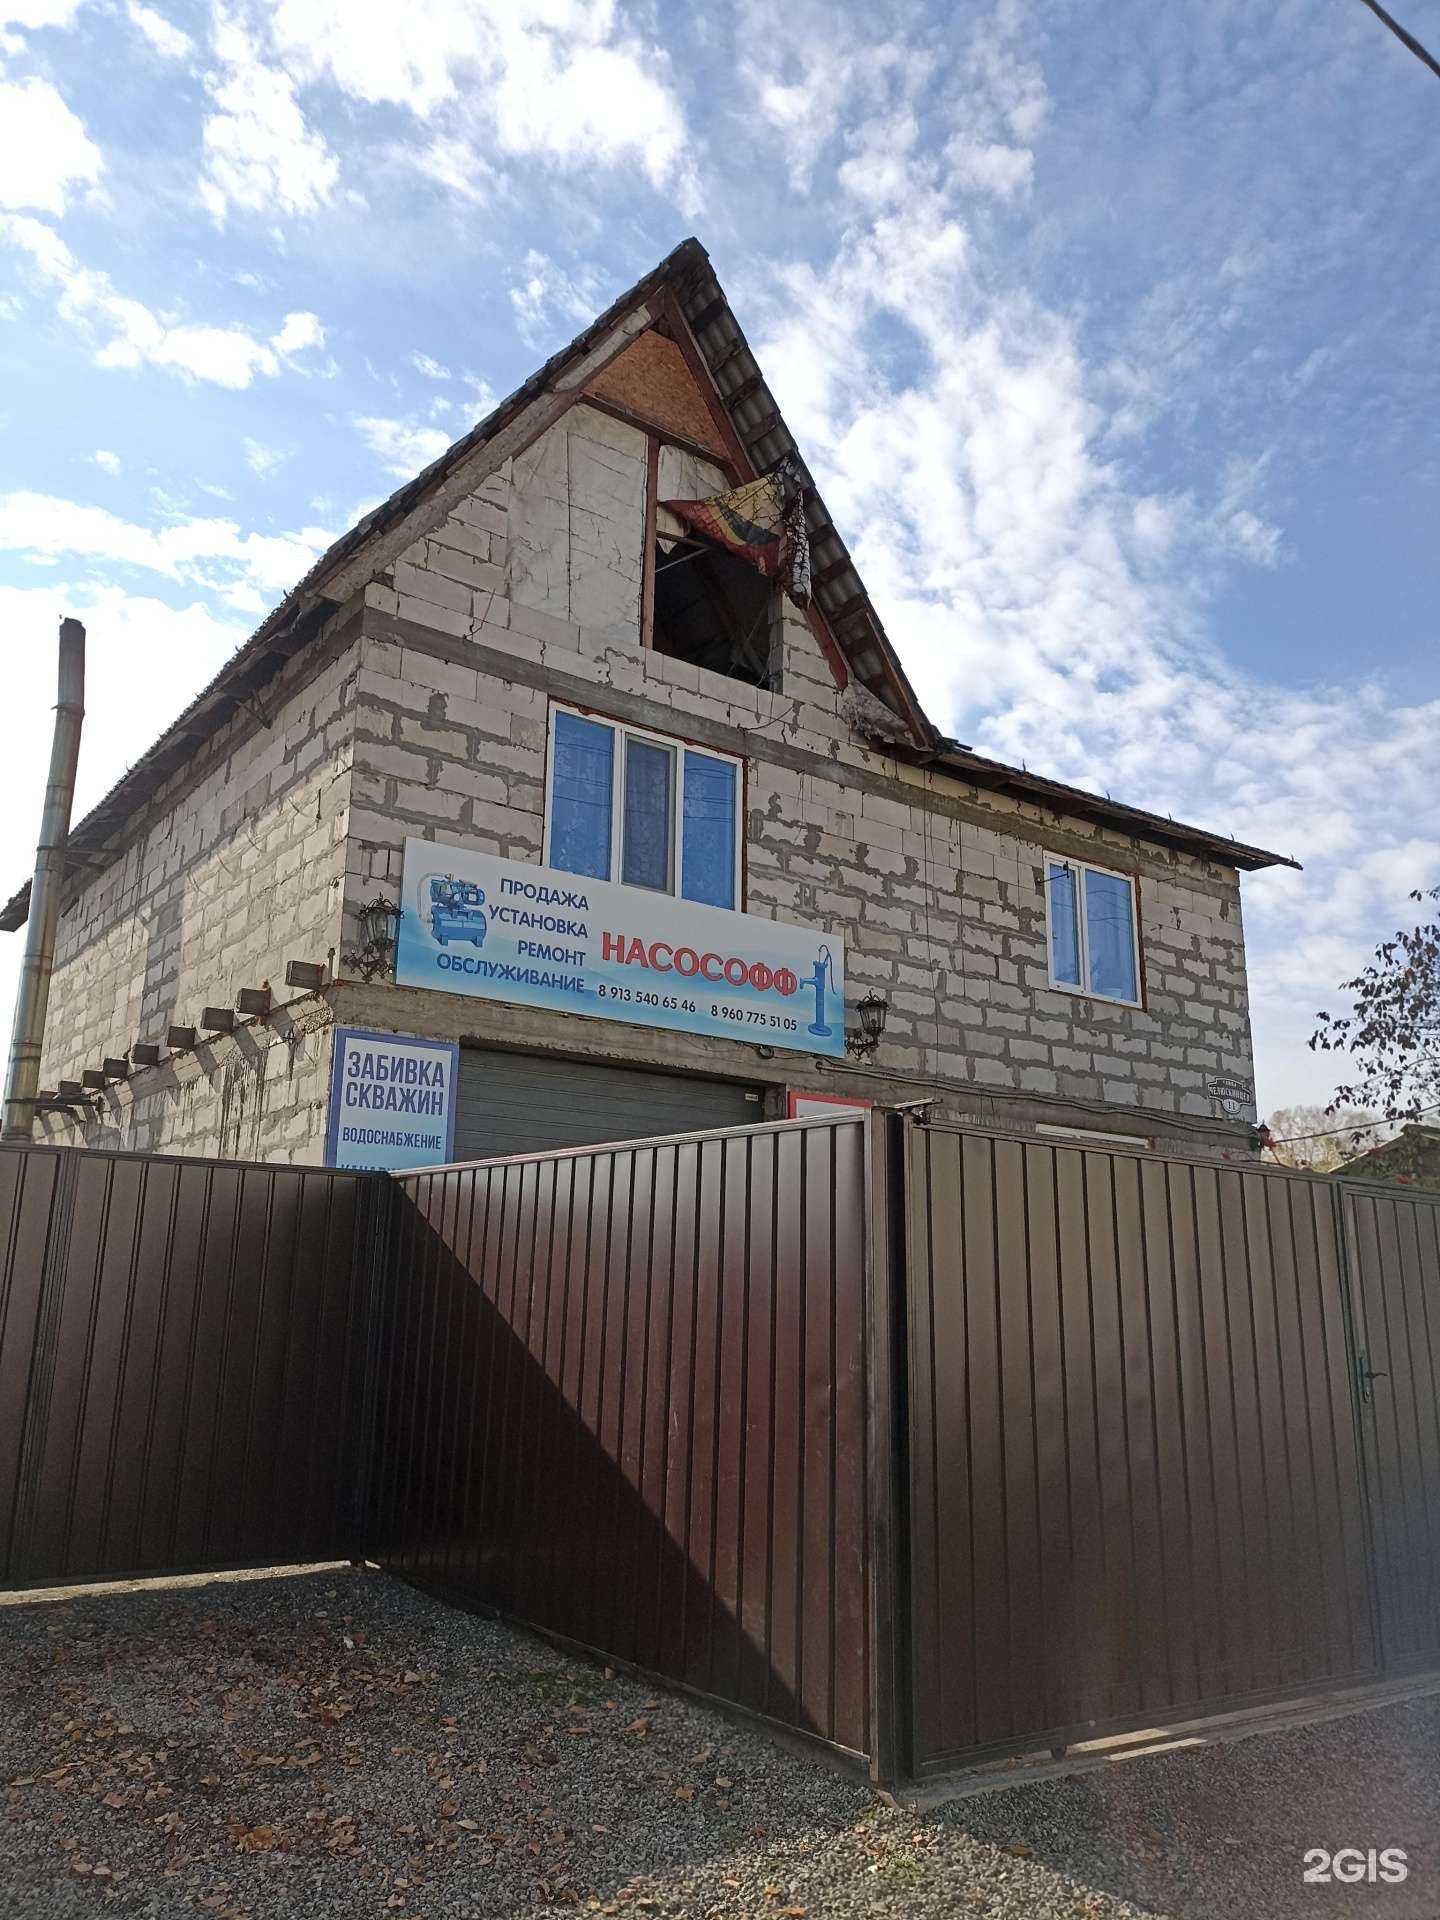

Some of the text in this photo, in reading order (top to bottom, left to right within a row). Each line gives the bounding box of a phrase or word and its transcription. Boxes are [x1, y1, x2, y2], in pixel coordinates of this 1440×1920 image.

[500, 877, 589, 911] ПРОДАЖА
[488, 904, 588, 939] УСТАНОВКА
[518, 939, 586, 967] РЕМОНТ
[602, 931, 797, 996] НАСОСОФФ
[436, 953, 585, 993] ОБСЛУЖИВАНИЕ
[598, 984, 696, 1013] 8 913 540 65 46
[711, 1005, 797, 1031] 8 960 775 51 05
[347, 1051, 445, 1088] ЗАБИВКА
[345, 1081, 444, 1116] СКВАЖИН
[342, 1127, 442, 1150] ВОДОСНАБЖЕНИЕ
